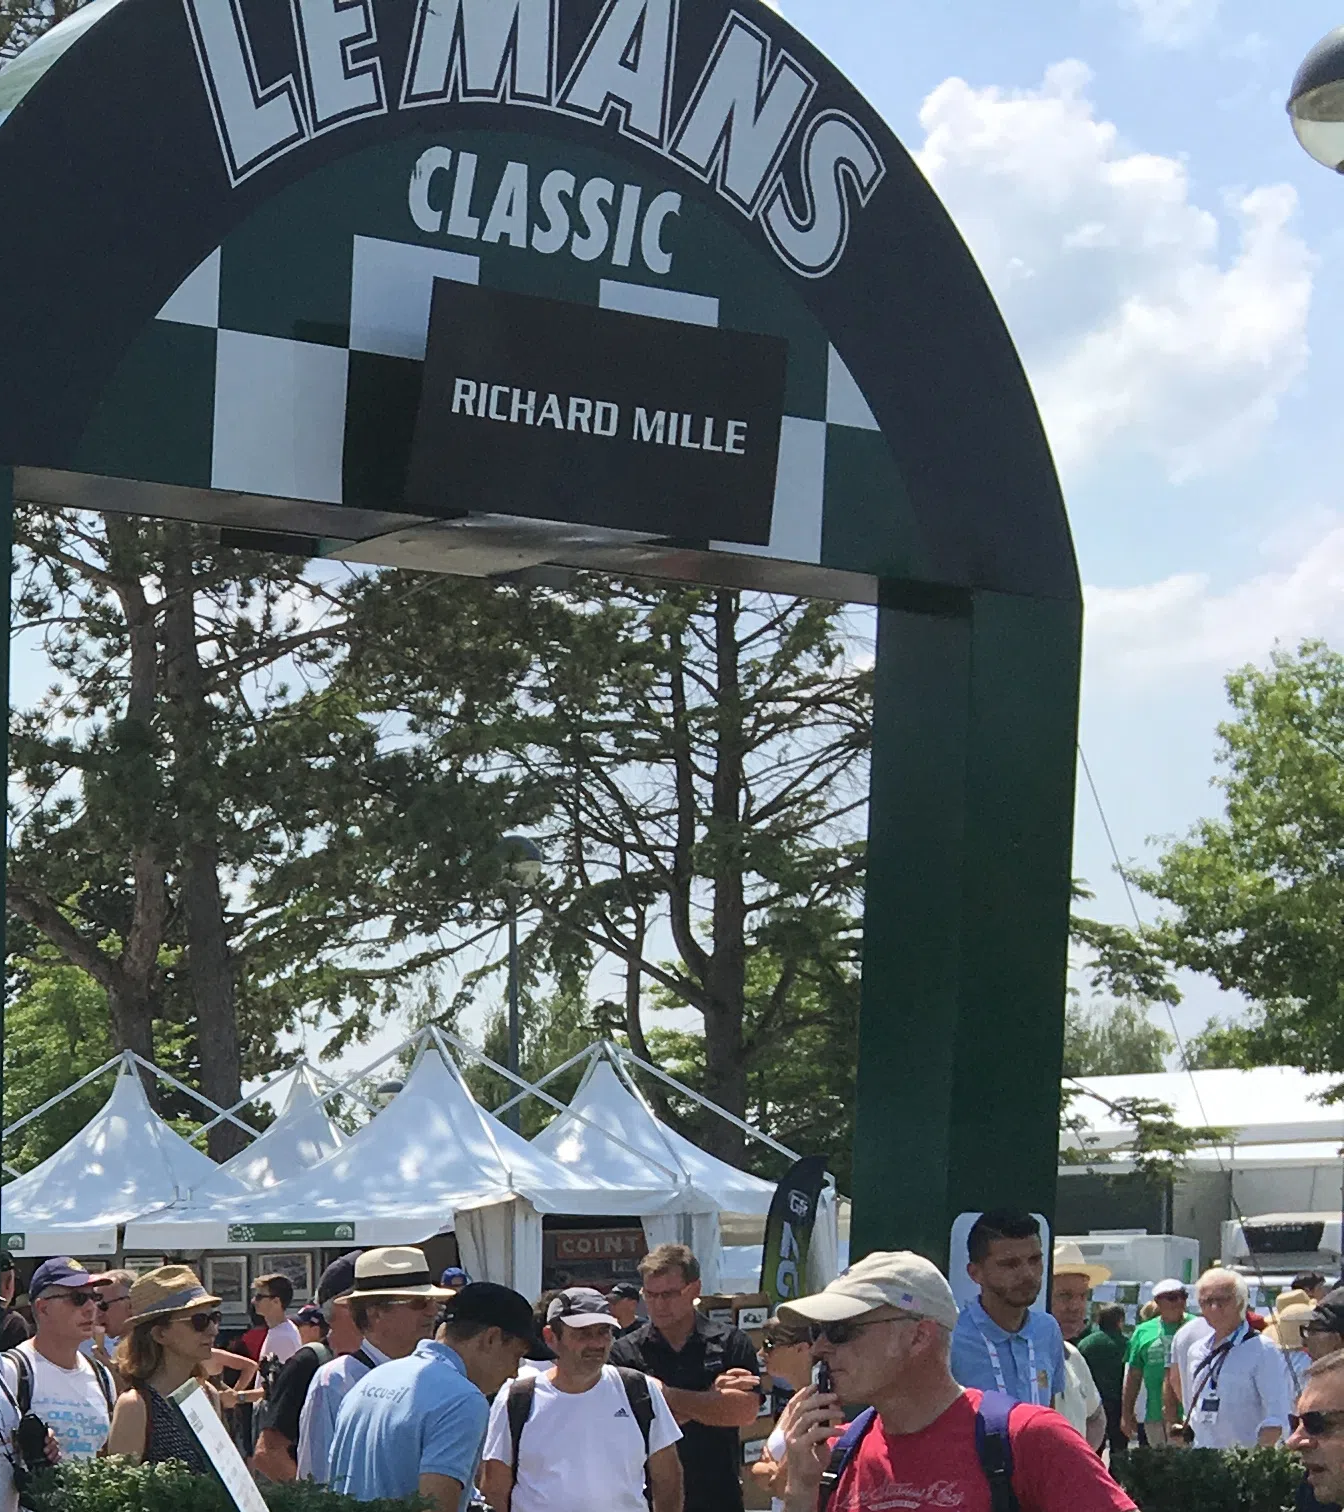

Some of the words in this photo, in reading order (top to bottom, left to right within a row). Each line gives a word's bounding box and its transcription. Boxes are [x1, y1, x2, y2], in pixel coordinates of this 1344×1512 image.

[183, 0, 388, 189] LE
[398, 0, 886, 279] MANS
[408, 144, 683, 275] CLASSIC
[450, 376, 620, 437] RICHARD
[632, 406, 749, 455] MILLE
[360, 1383, 410, 1403] Accueil
